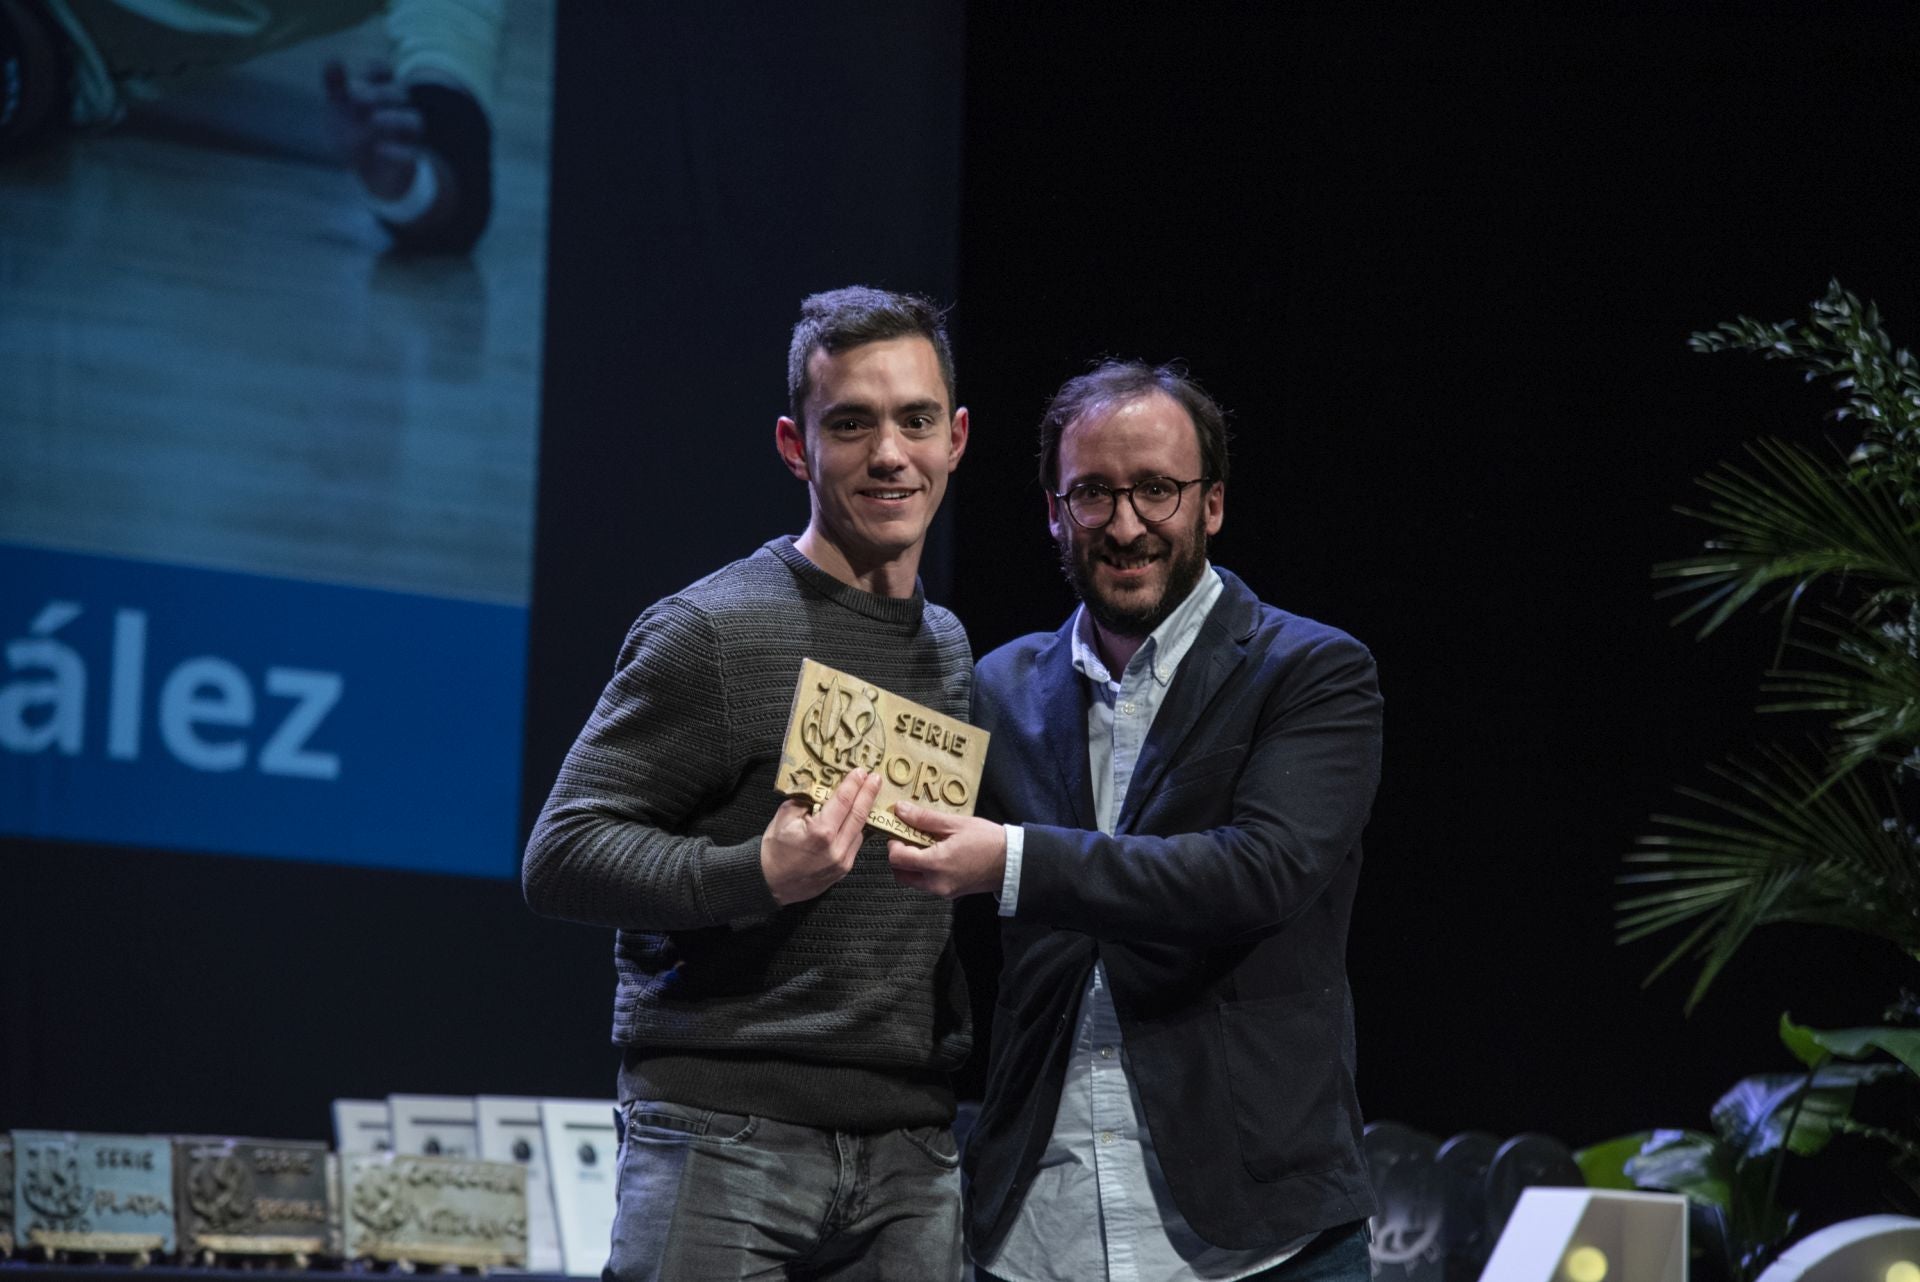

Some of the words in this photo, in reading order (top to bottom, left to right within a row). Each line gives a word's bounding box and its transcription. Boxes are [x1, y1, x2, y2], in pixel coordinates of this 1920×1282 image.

[894, 713, 967, 758] SERIE
[885, 754, 969, 806] ORO
[96, 1149, 154, 1170] SERIE
